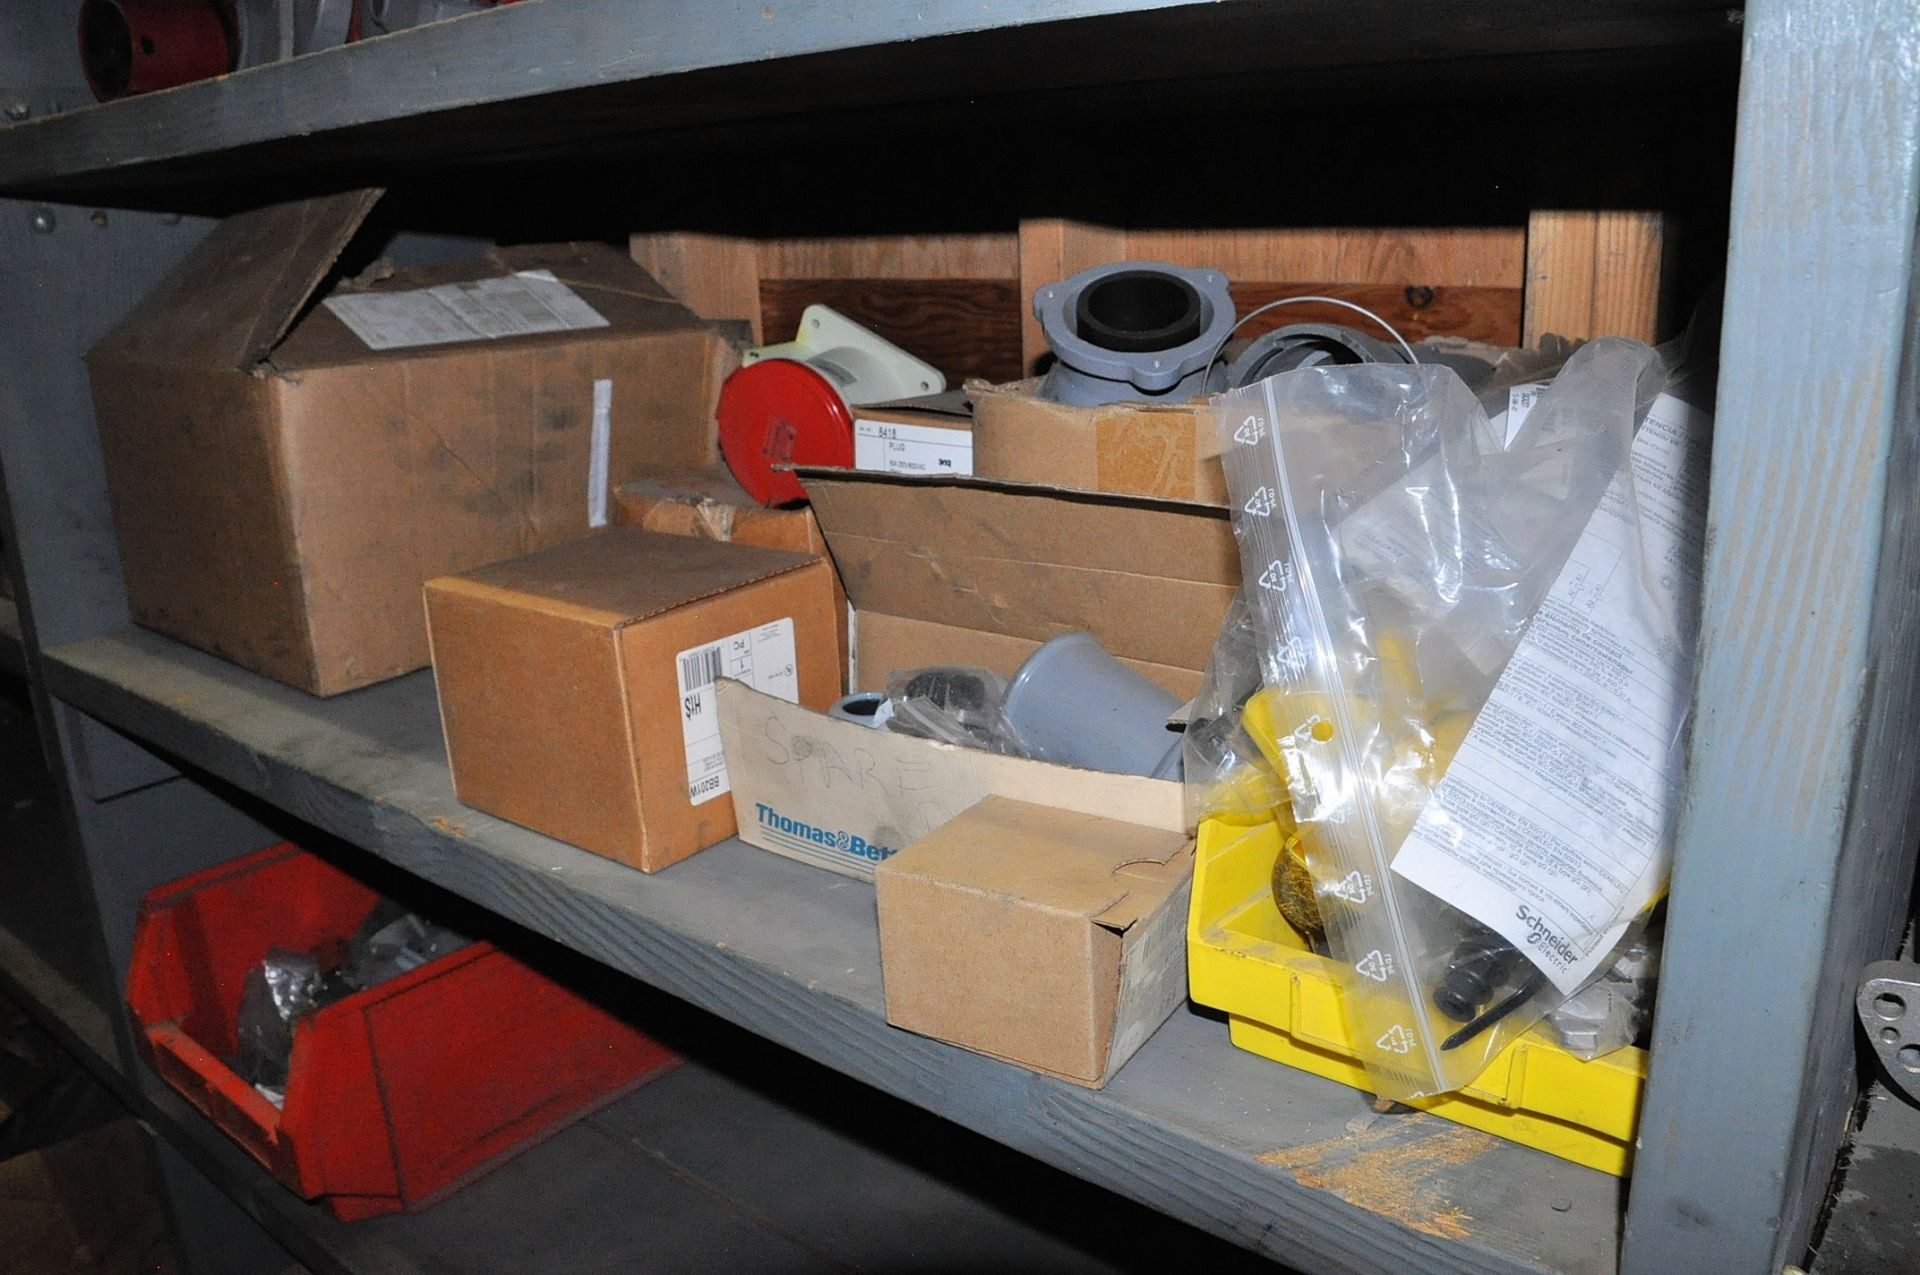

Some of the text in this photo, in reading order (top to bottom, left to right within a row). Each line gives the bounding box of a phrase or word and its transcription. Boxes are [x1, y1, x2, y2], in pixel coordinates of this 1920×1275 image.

[756, 802, 898, 862] Thomas&Bet
[1515, 904, 1578, 965] Schneider
[1538, 942, 1568, 974] Electric
